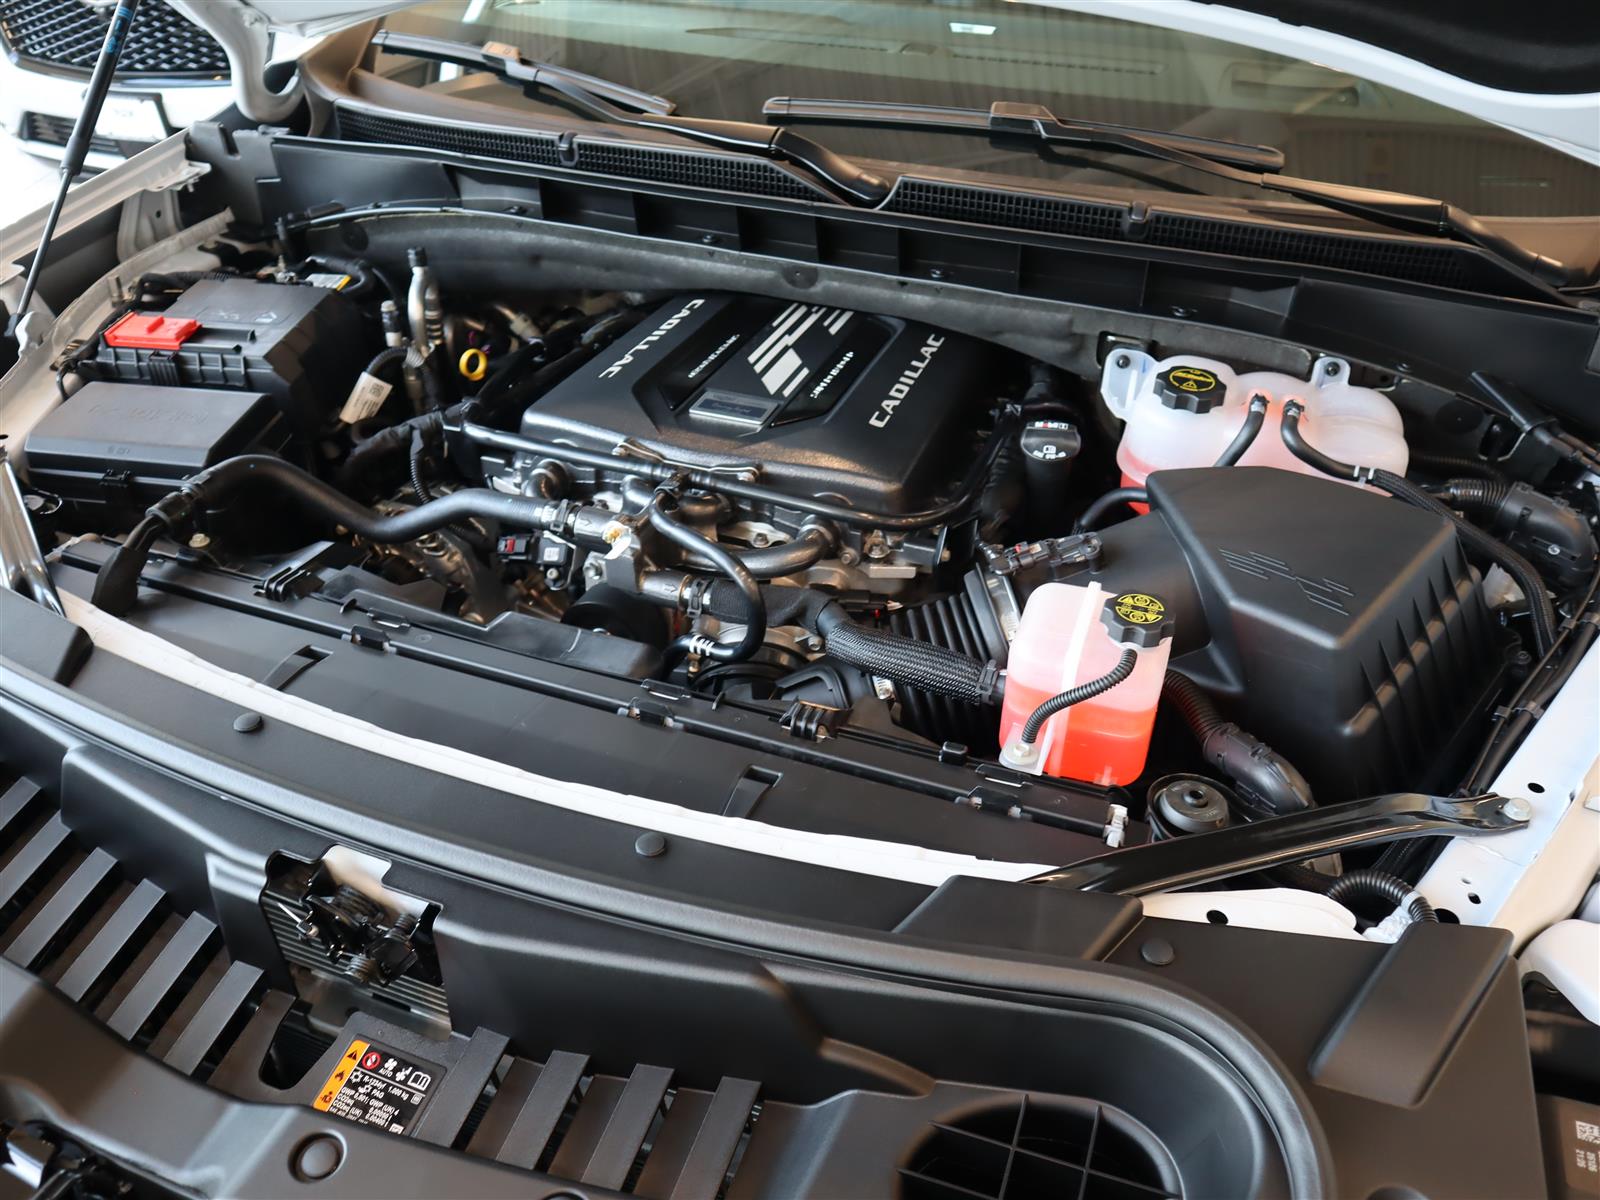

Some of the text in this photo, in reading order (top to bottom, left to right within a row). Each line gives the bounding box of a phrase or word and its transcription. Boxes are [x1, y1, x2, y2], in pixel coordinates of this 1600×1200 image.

[598, 298, 706, 379] CADILLAC
[868, 333, 946, 428] CADILLAC
[378, 1068, 393, 1077] AUTO
